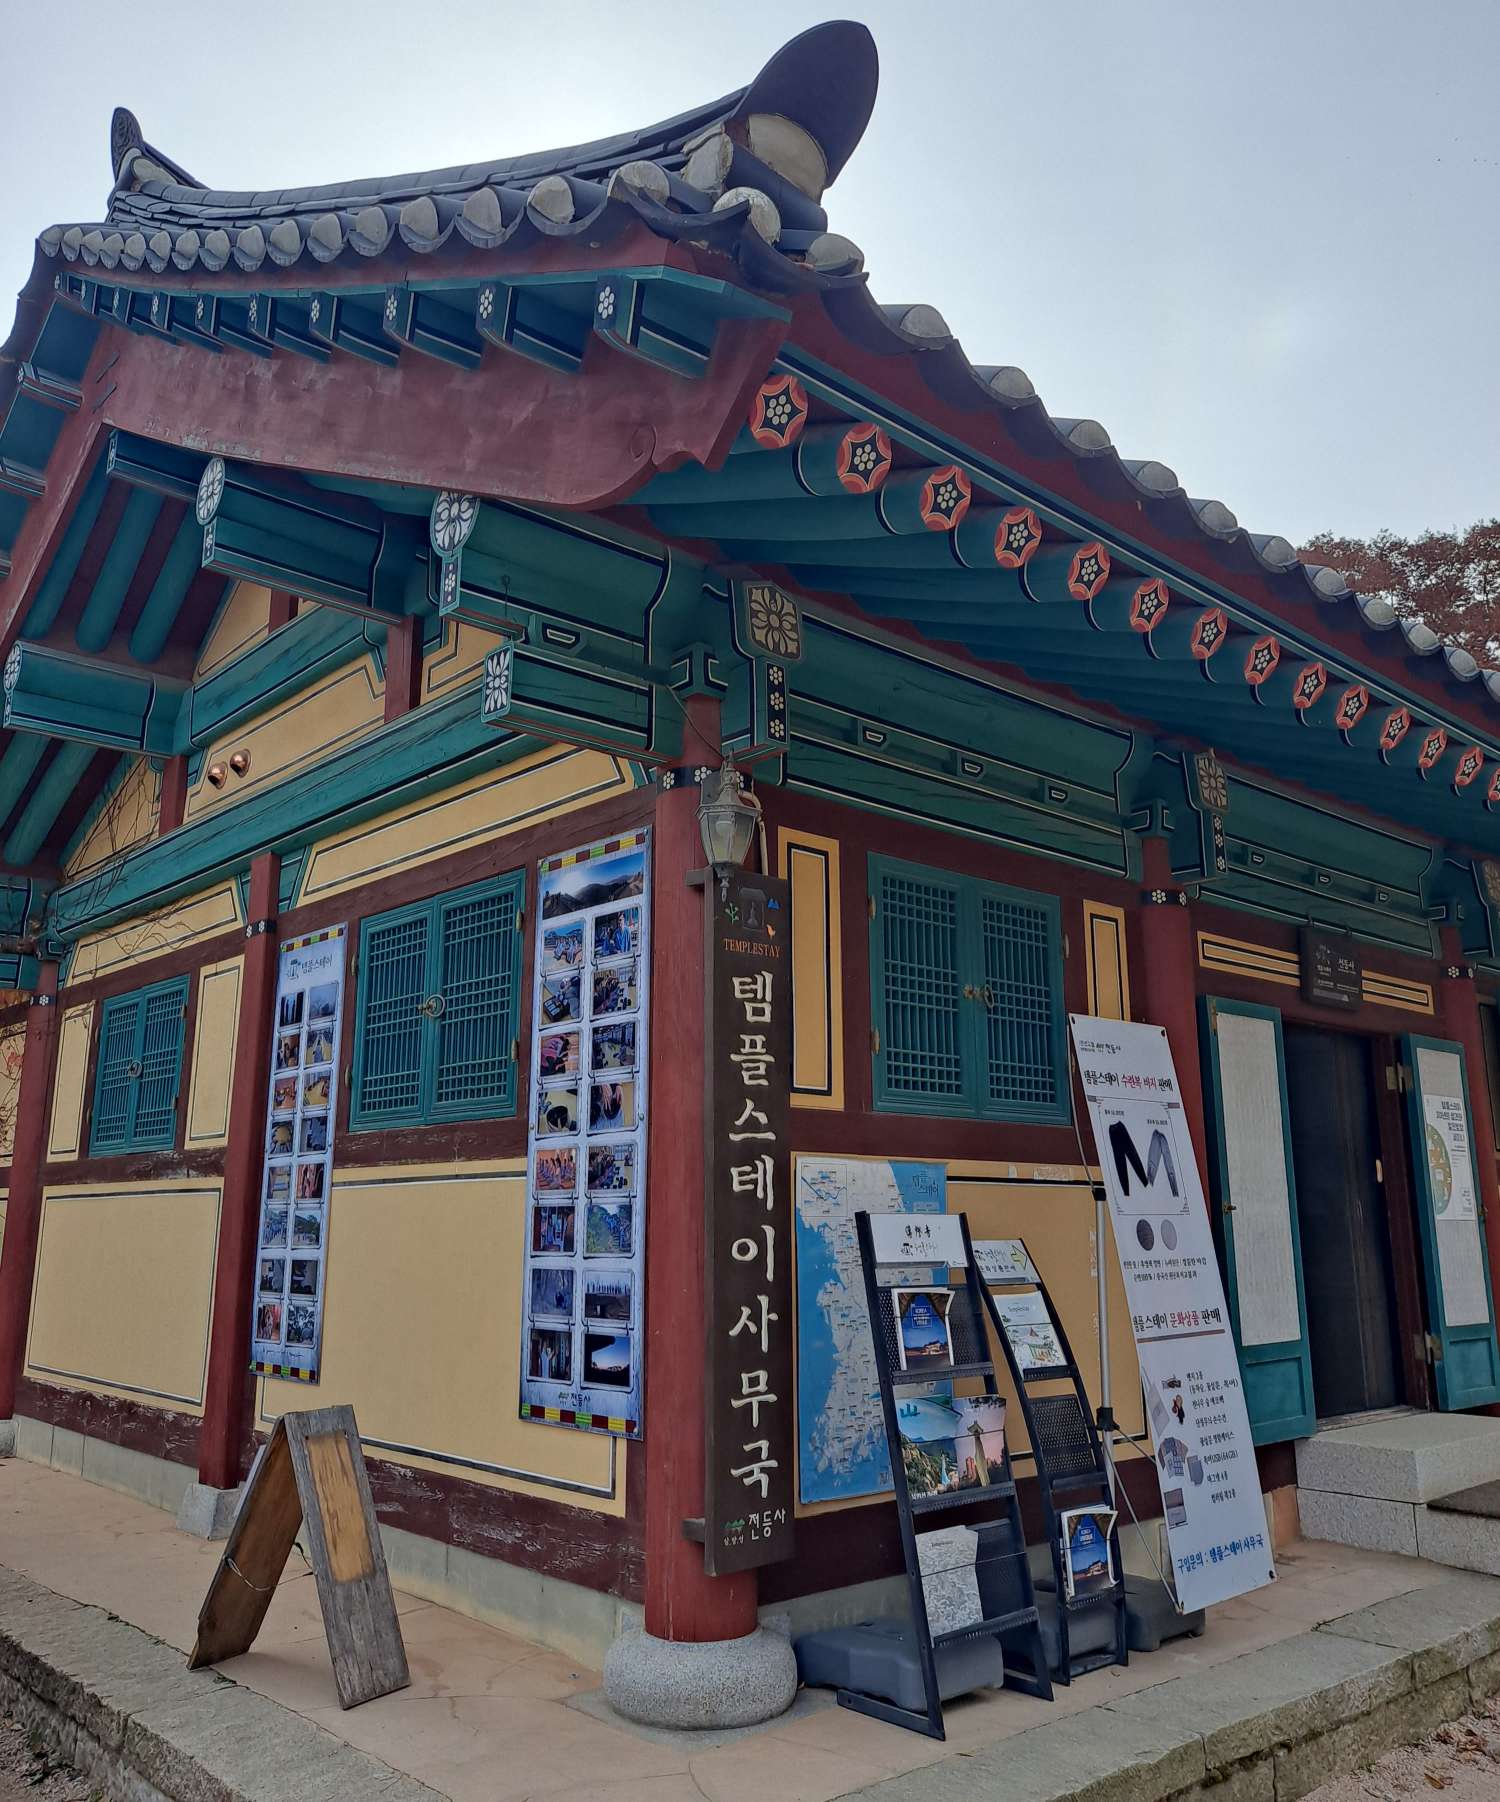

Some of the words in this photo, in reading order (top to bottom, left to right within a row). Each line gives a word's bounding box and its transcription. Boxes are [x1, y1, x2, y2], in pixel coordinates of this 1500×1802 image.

[723, 938, 781, 958] TEMPLESTAY
[1084, 1069, 1120, 1088] 템플스테이
[1157, 1078, 1174, 1092] 판매
[1169, 1310, 1200, 1328] 문화상품
[1200, 1307, 1222, 1324] 판매
[748, 1508, 786, 1540] 전등사
[1178, 1552, 1204, 1575] 구입문의
[1243, 1533, 1265, 1552] 사무국
